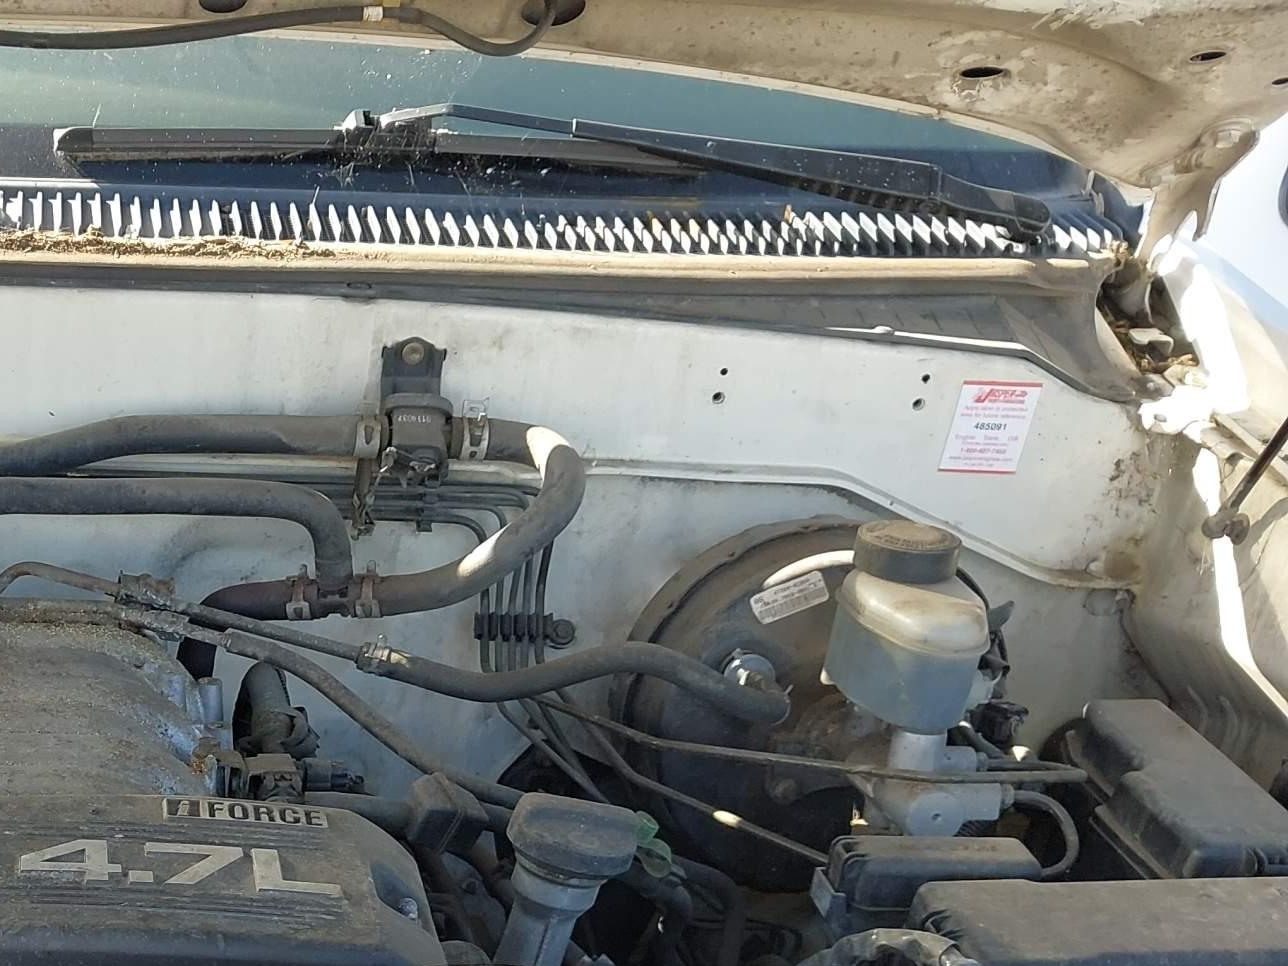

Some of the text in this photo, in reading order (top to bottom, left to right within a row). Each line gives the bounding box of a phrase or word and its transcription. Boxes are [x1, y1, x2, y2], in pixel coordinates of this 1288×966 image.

[974, 422, 1007, 431] 485091
[207, 801, 324, 826] FORCE
[19, 838, 343, 896] 4.7L
